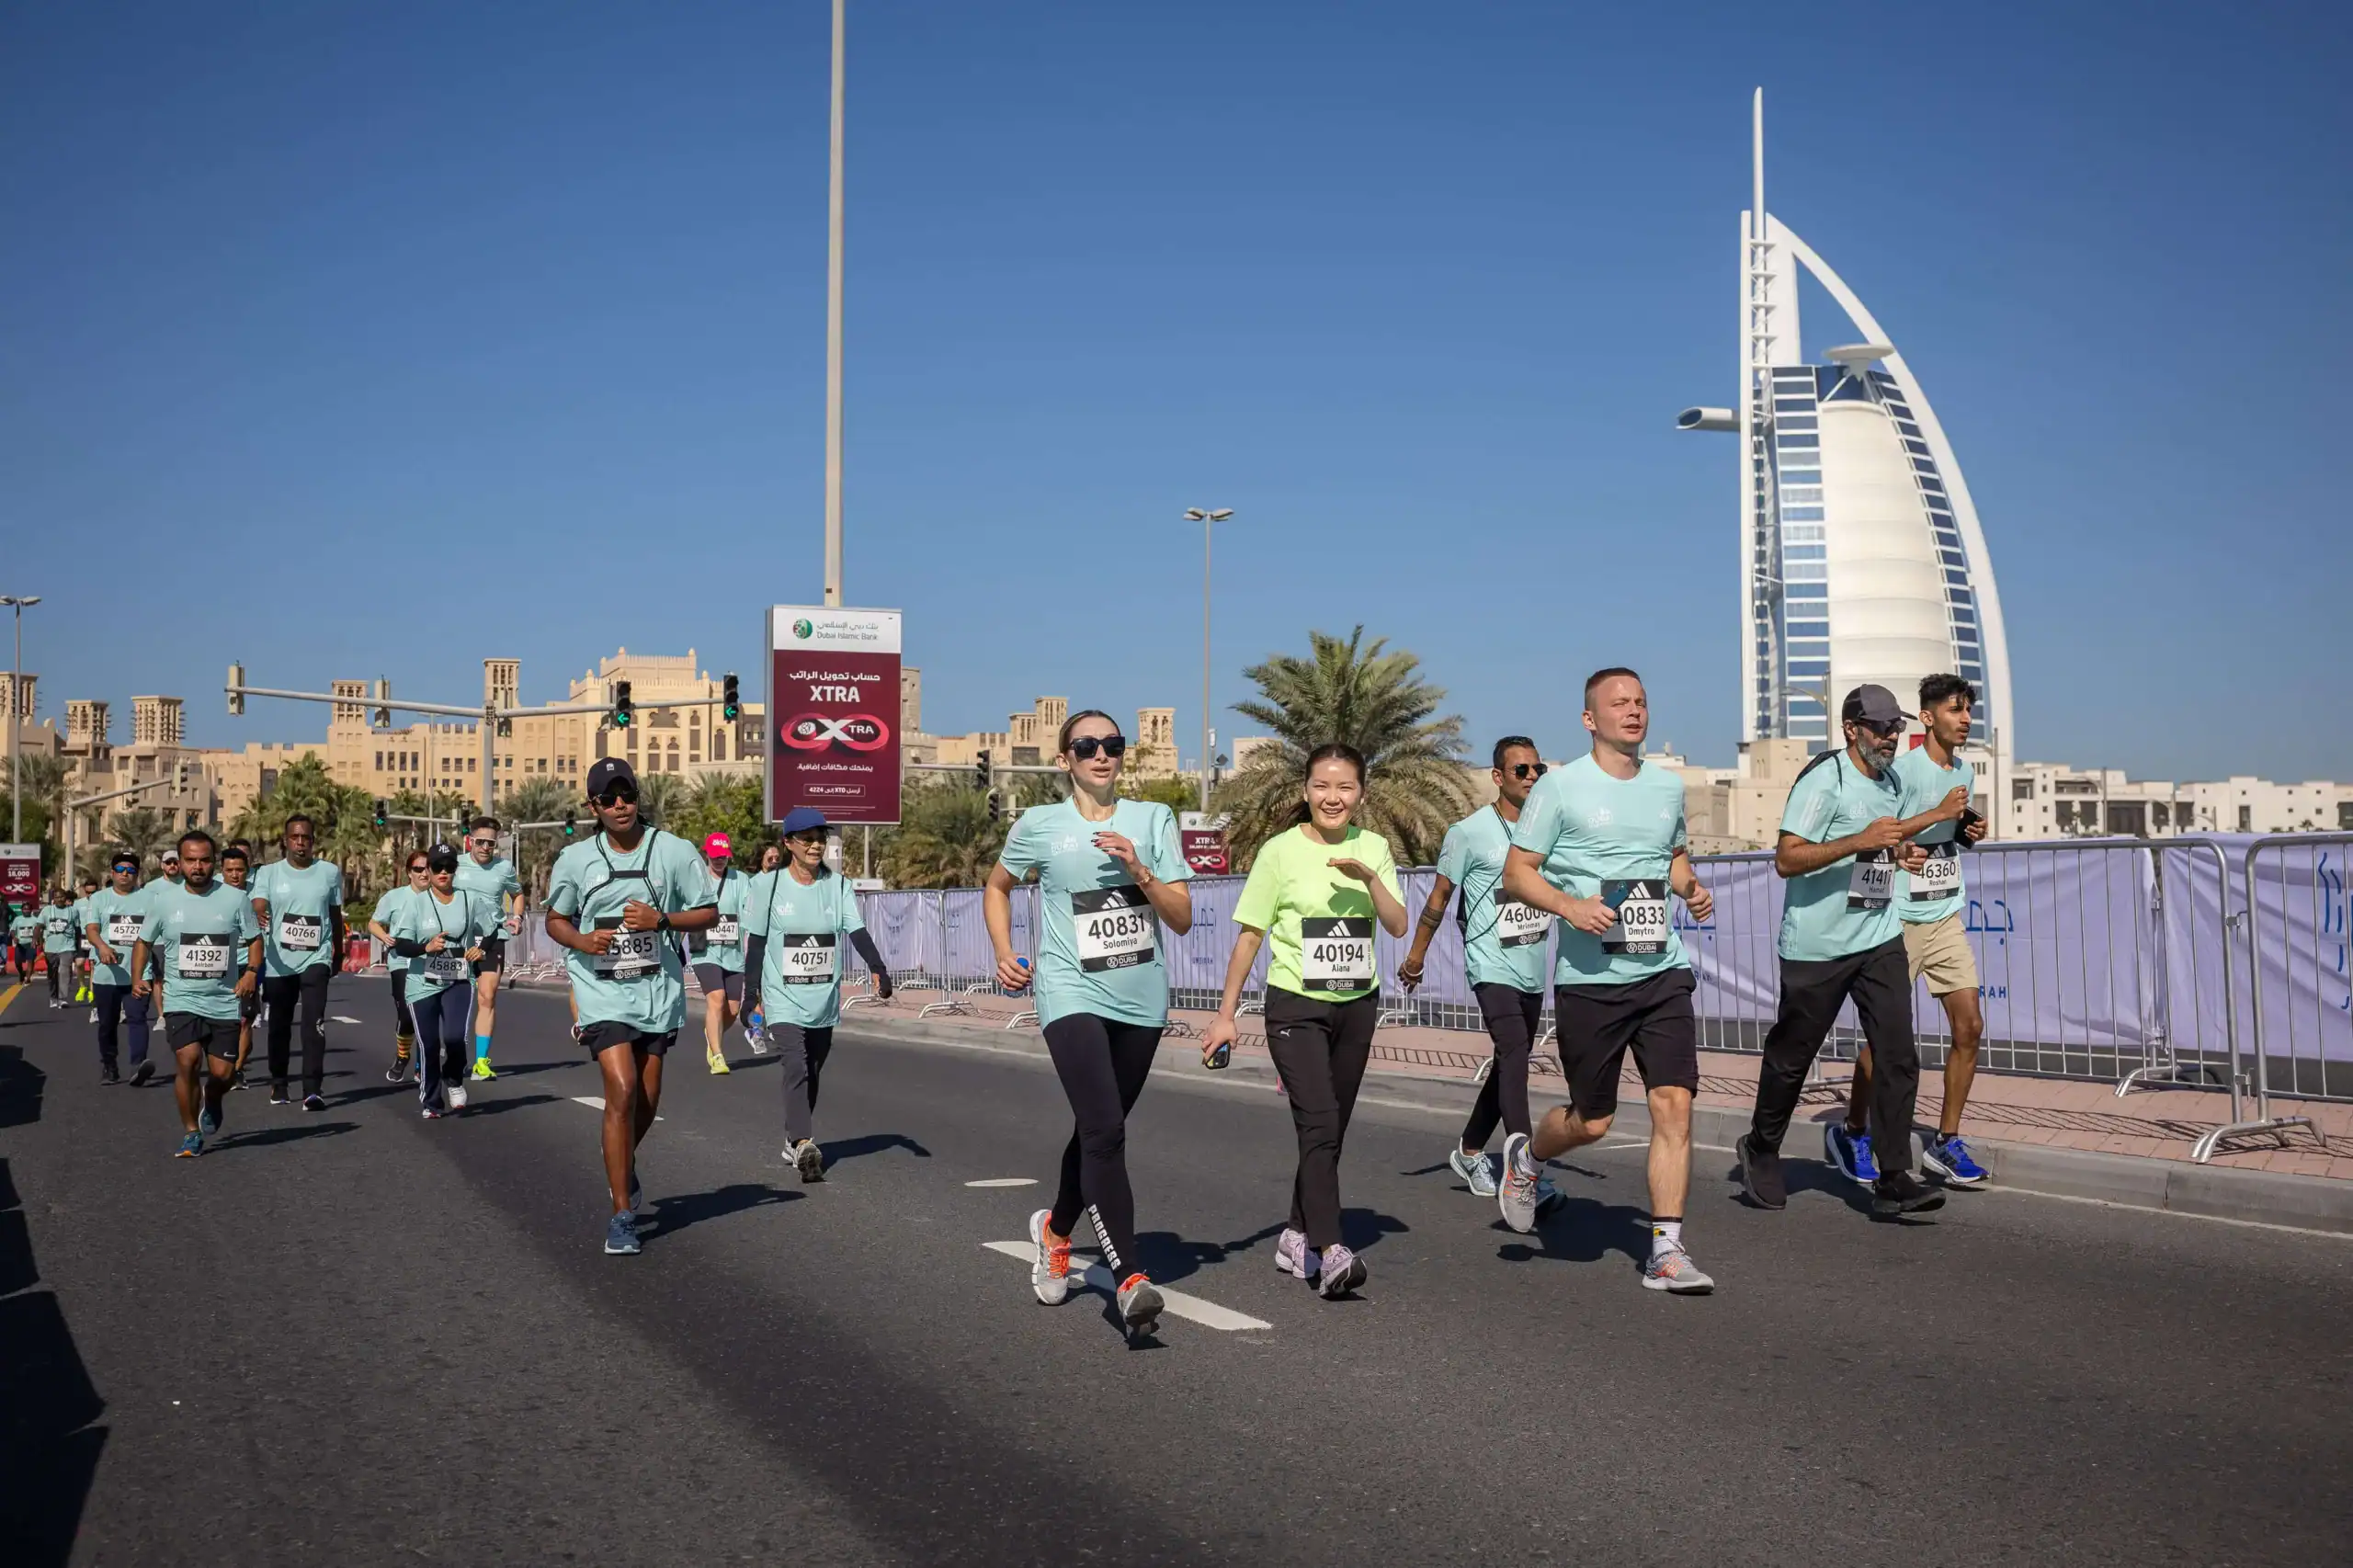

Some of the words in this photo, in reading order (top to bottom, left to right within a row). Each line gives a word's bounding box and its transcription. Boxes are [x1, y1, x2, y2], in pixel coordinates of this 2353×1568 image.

[861, 632, 879, 641] Bank
[790, 670, 818, 681] الراتب
[819, 671, 849, 681] تحويل
[851, 672, 881, 682] حساب
[810, 686, 860, 702] XTRA
[848, 765, 873, 773] يمنحك
[1861, 869, 1893, 885] 41417
[113, 926, 140, 935] 45727
[285, 926, 316, 938] 40766
[1088, 913, 1145, 939] 40831
[1628, 927, 1655, 937] Dmytro
[610, 937, 654, 955] 5885
[1103, 937, 1138, 949] Solomiya
[186, 949, 222, 962] 41392
[791, 951, 828, 965] 40751
[1313, 944, 1364, 962] 40194
[1120, 955, 1138, 964] DUBAI
[1332, 964, 1350, 972] Aiana
[1087, 1204, 1121, 1270] PROGRESS
